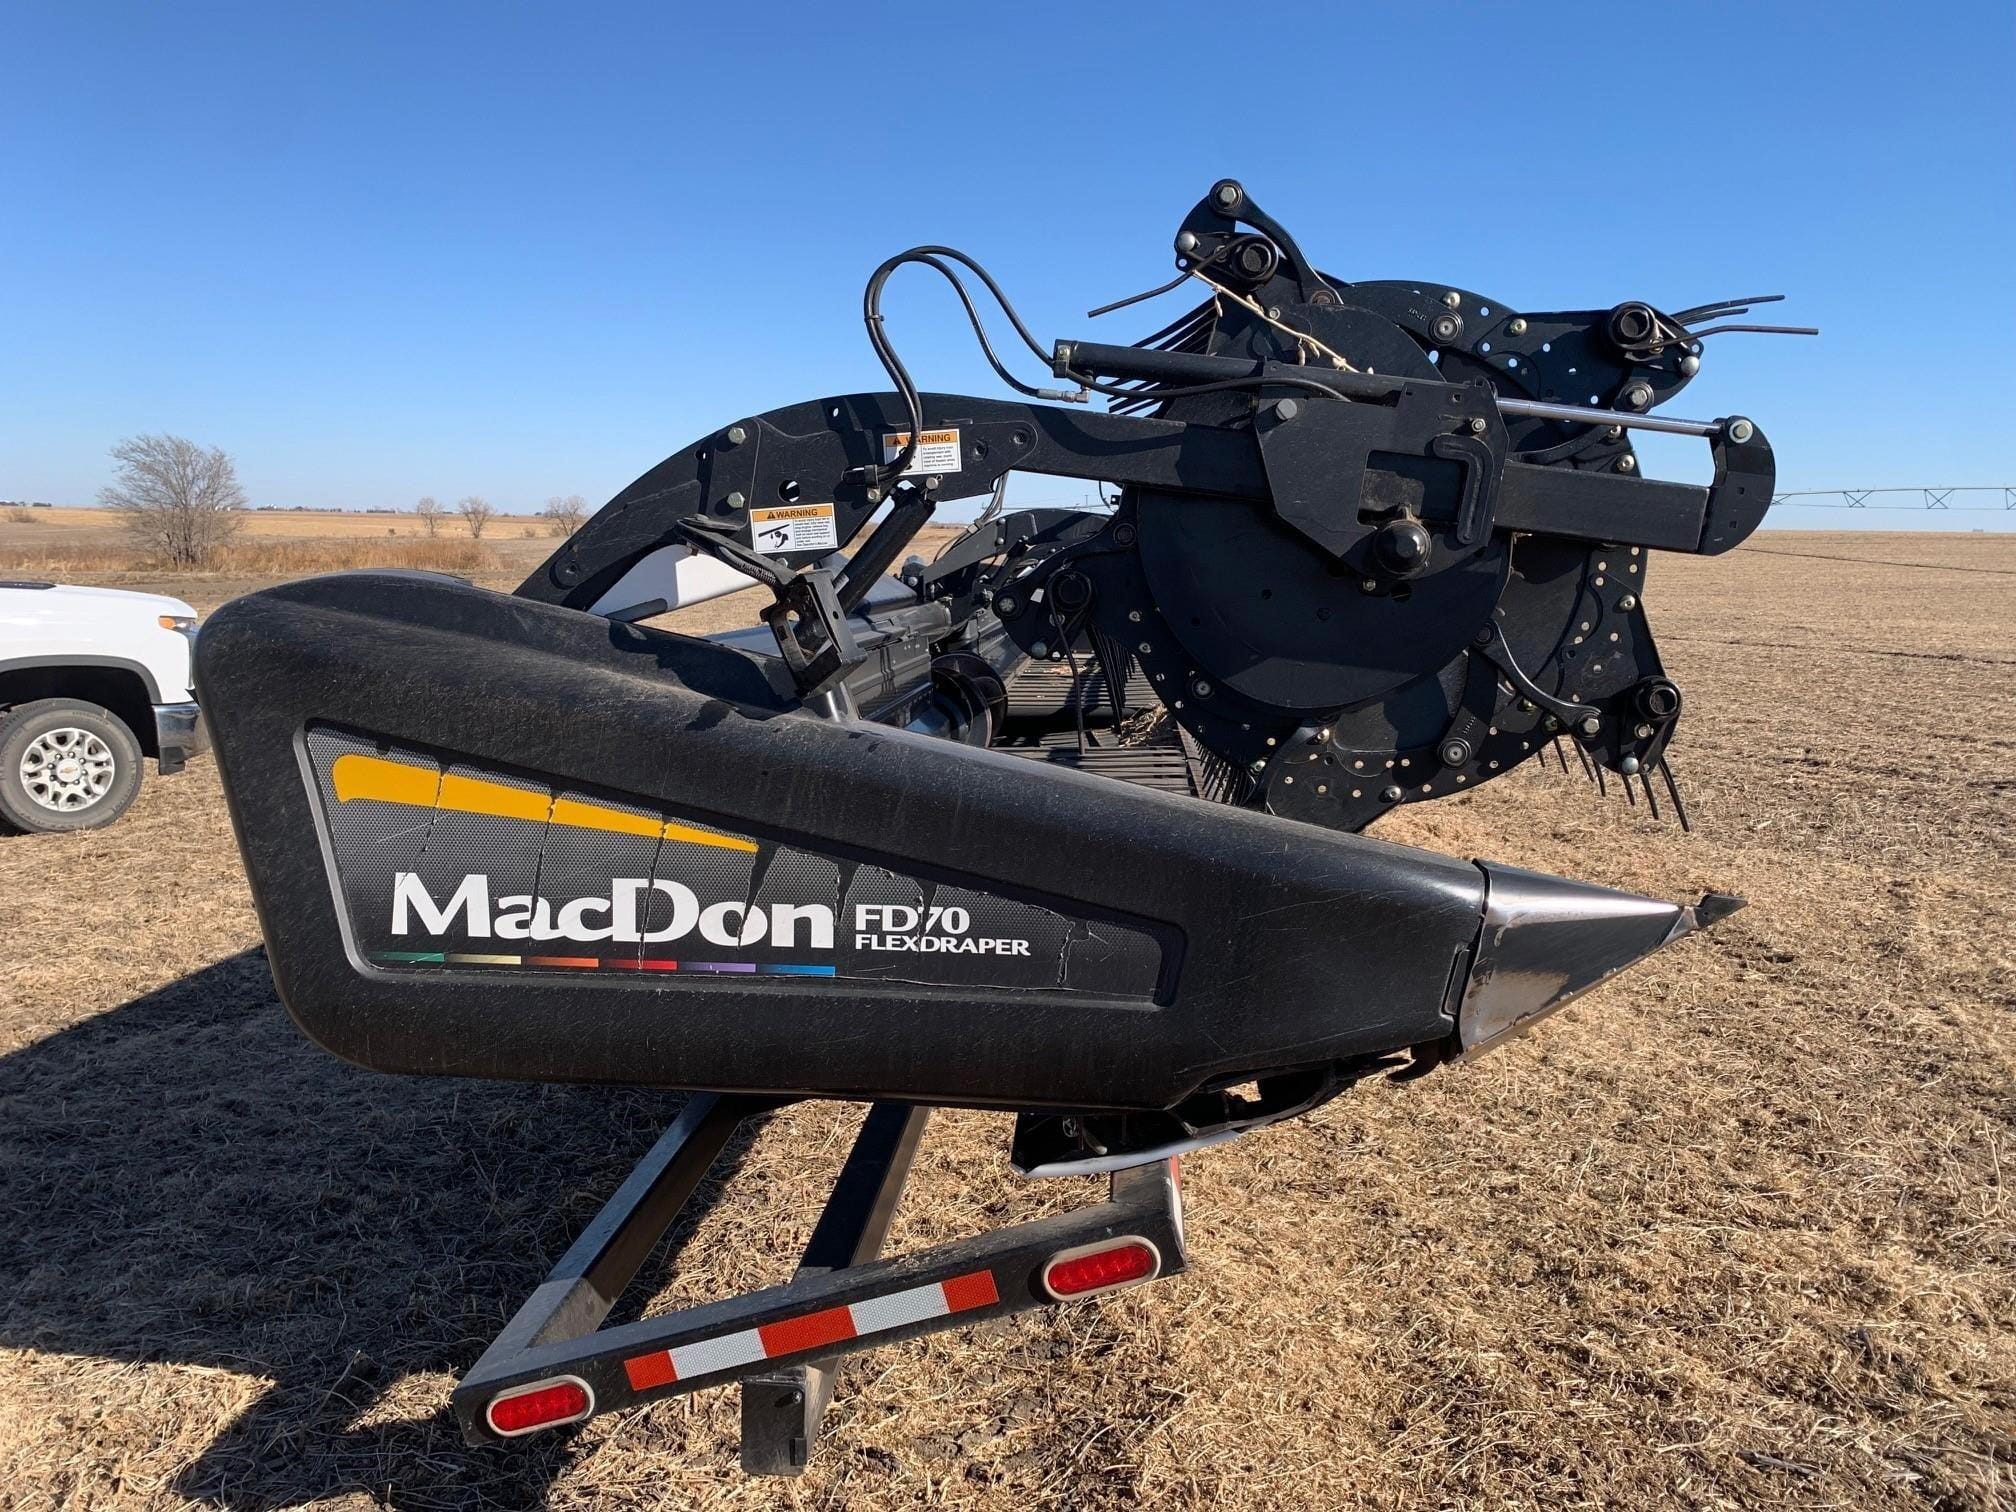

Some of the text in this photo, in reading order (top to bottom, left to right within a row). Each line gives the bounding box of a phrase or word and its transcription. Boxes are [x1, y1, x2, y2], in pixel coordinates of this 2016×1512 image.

[906, 434, 951, 443] RNING
[775, 508, 818, 519] WARNING
[391, 872, 835, 949] MacDon
[855, 904, 970, 934] FD70
[855, 934, 1031, 956] FLEXDRAPER
